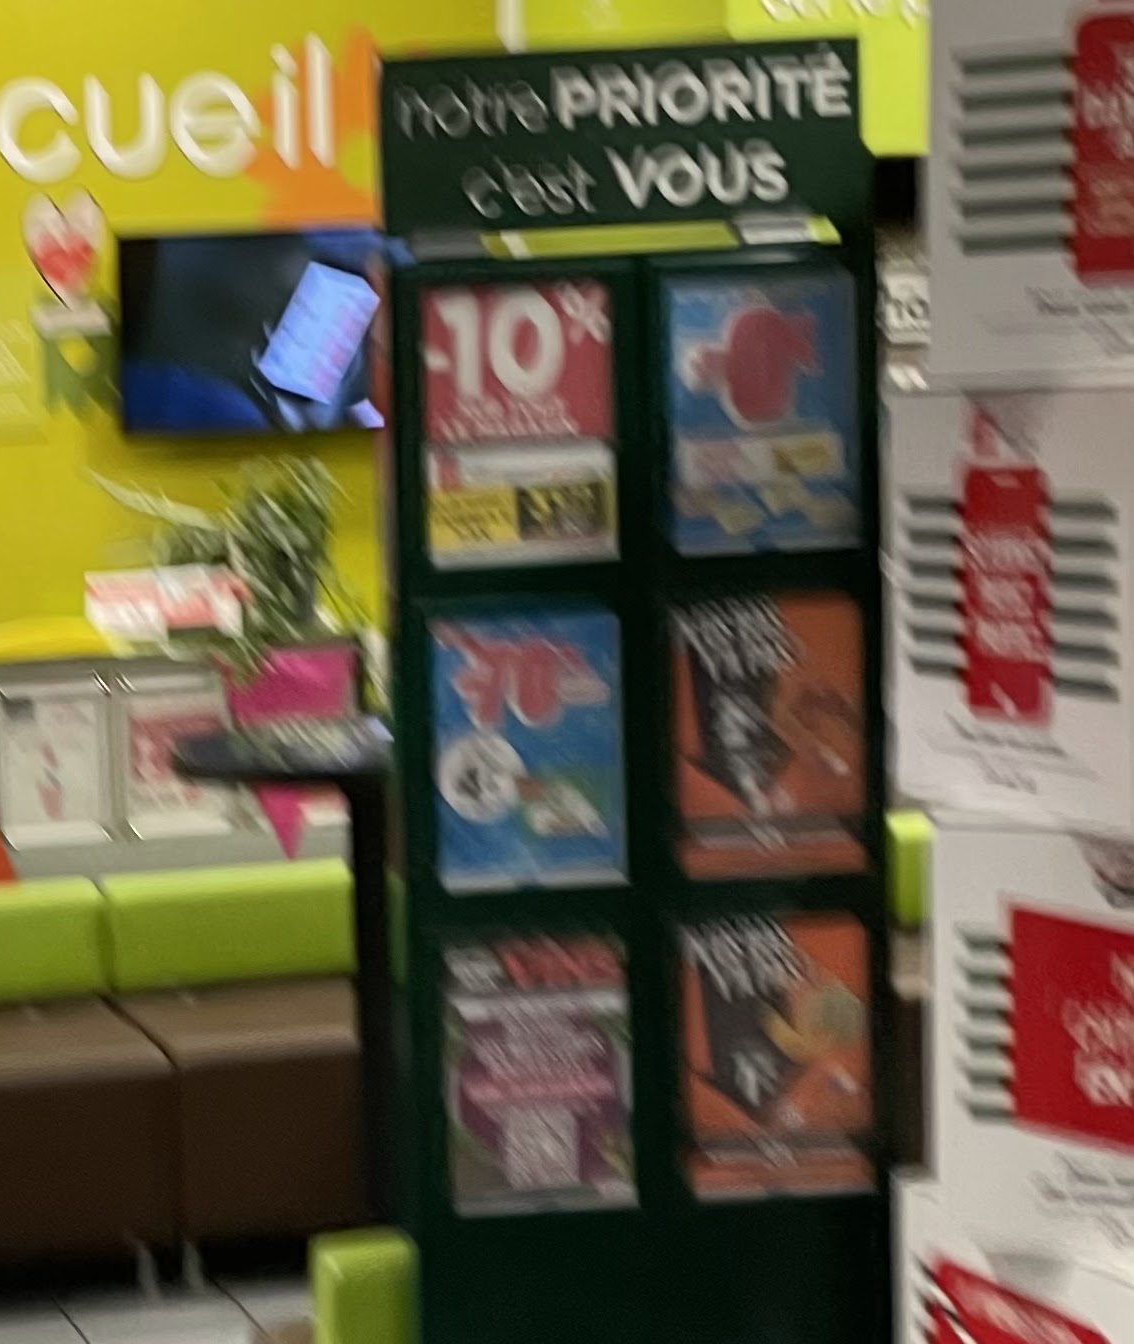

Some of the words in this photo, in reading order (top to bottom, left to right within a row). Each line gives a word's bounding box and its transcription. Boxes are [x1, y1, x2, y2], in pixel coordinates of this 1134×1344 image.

[395, 78, 548, 141] notre
[550, 43, 852, 131] PRIORITÉ
[462, 154, 597, 219] c'est
[602, 139, 791, 209] VOUS
